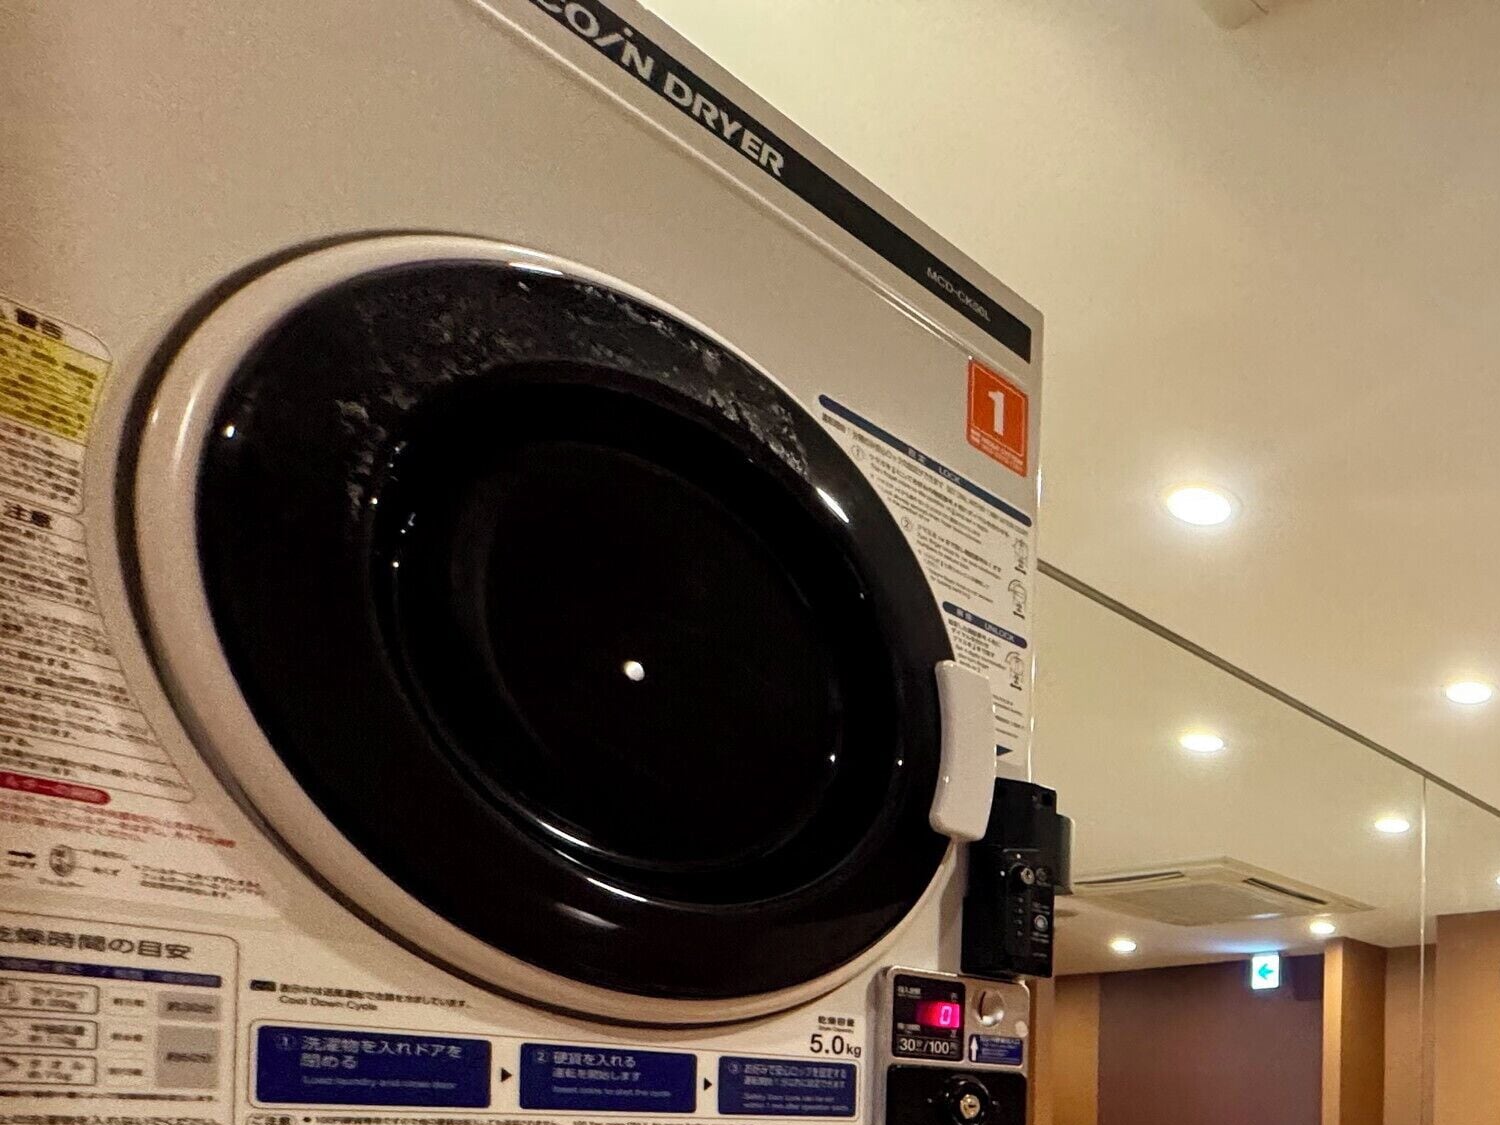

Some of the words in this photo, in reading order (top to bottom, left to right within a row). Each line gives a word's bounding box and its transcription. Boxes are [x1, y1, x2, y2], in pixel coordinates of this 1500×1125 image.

[662, 71, 785, 177] DRYER
[986, 389, 1006, 437] 1
[984, 621, 1015, 643] UNLOCK
[939, 1005, 953, 1025] 0
